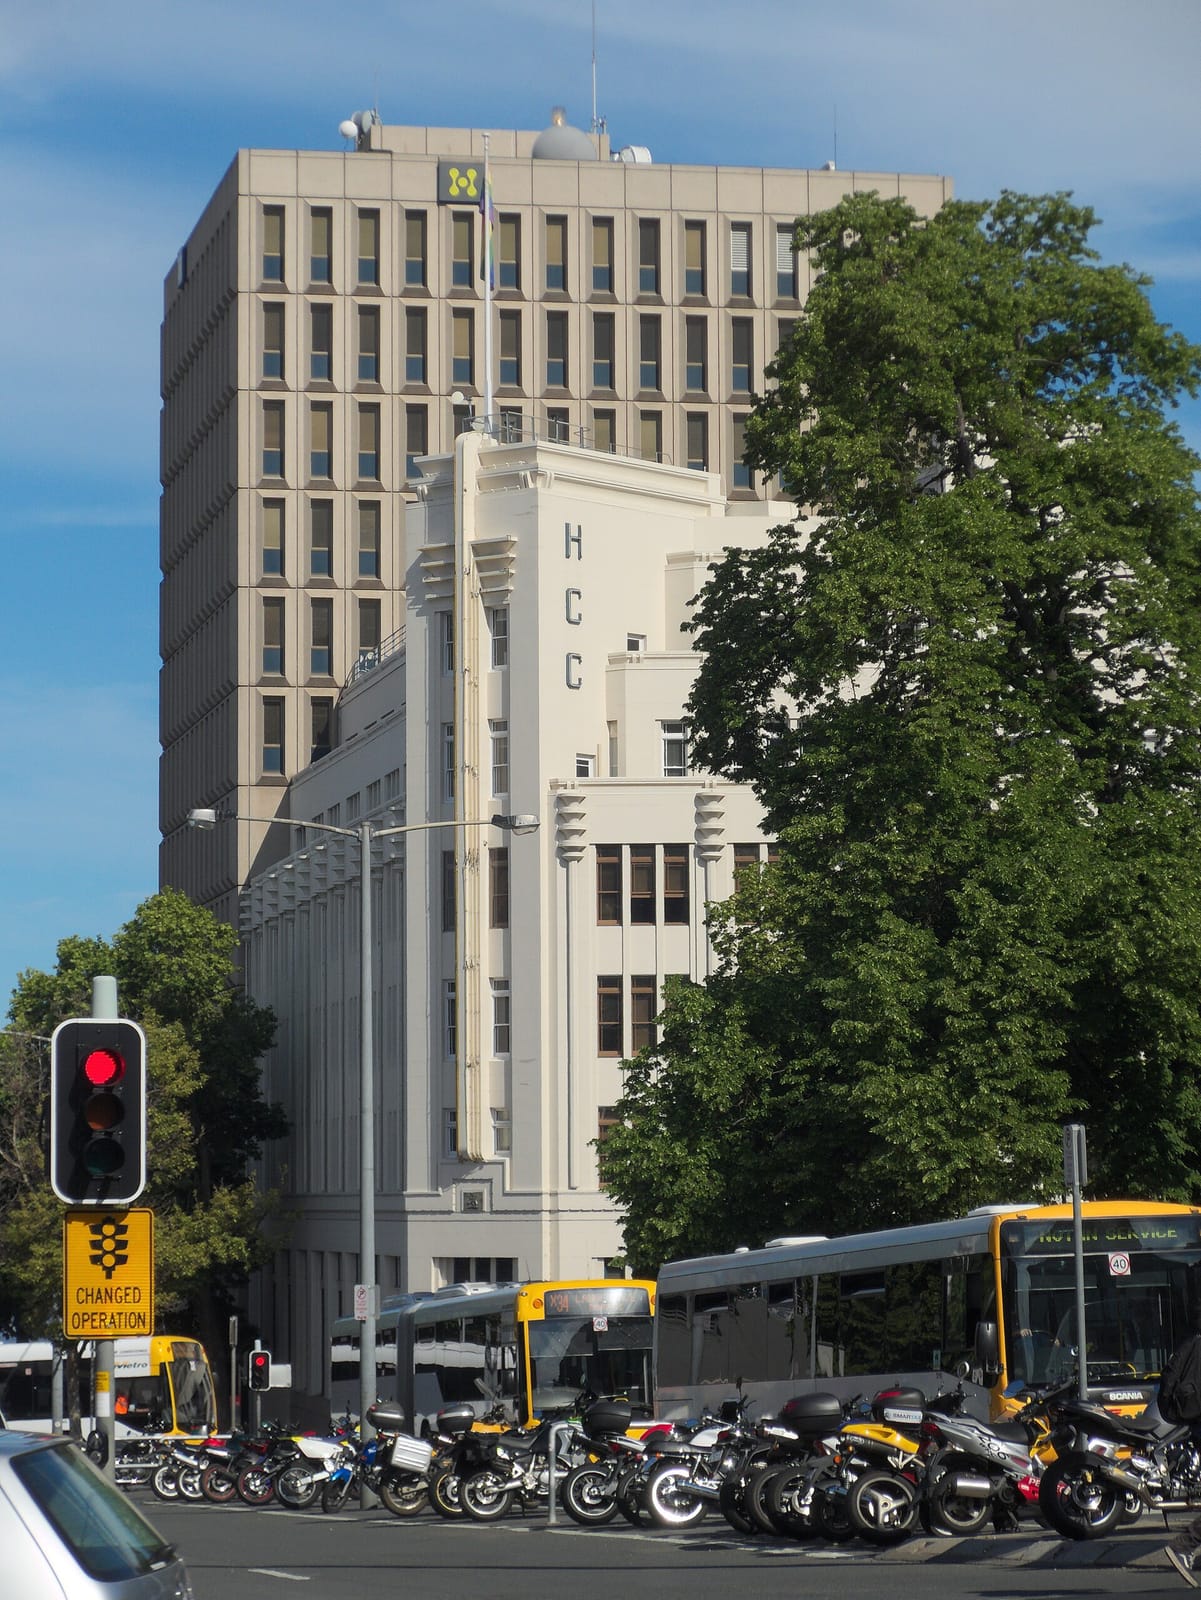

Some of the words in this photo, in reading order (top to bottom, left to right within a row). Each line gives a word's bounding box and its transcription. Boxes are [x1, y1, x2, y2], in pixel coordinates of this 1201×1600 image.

[1112, 1259, 1126, 1270] 40
[77, 1287, 141, 1304] CHANGED
[72, 1312, 146, 1329] OPERATION
[596, 1319, 606, 1328] 40
[1109, 1391, 1144, 1401] SCANIA
